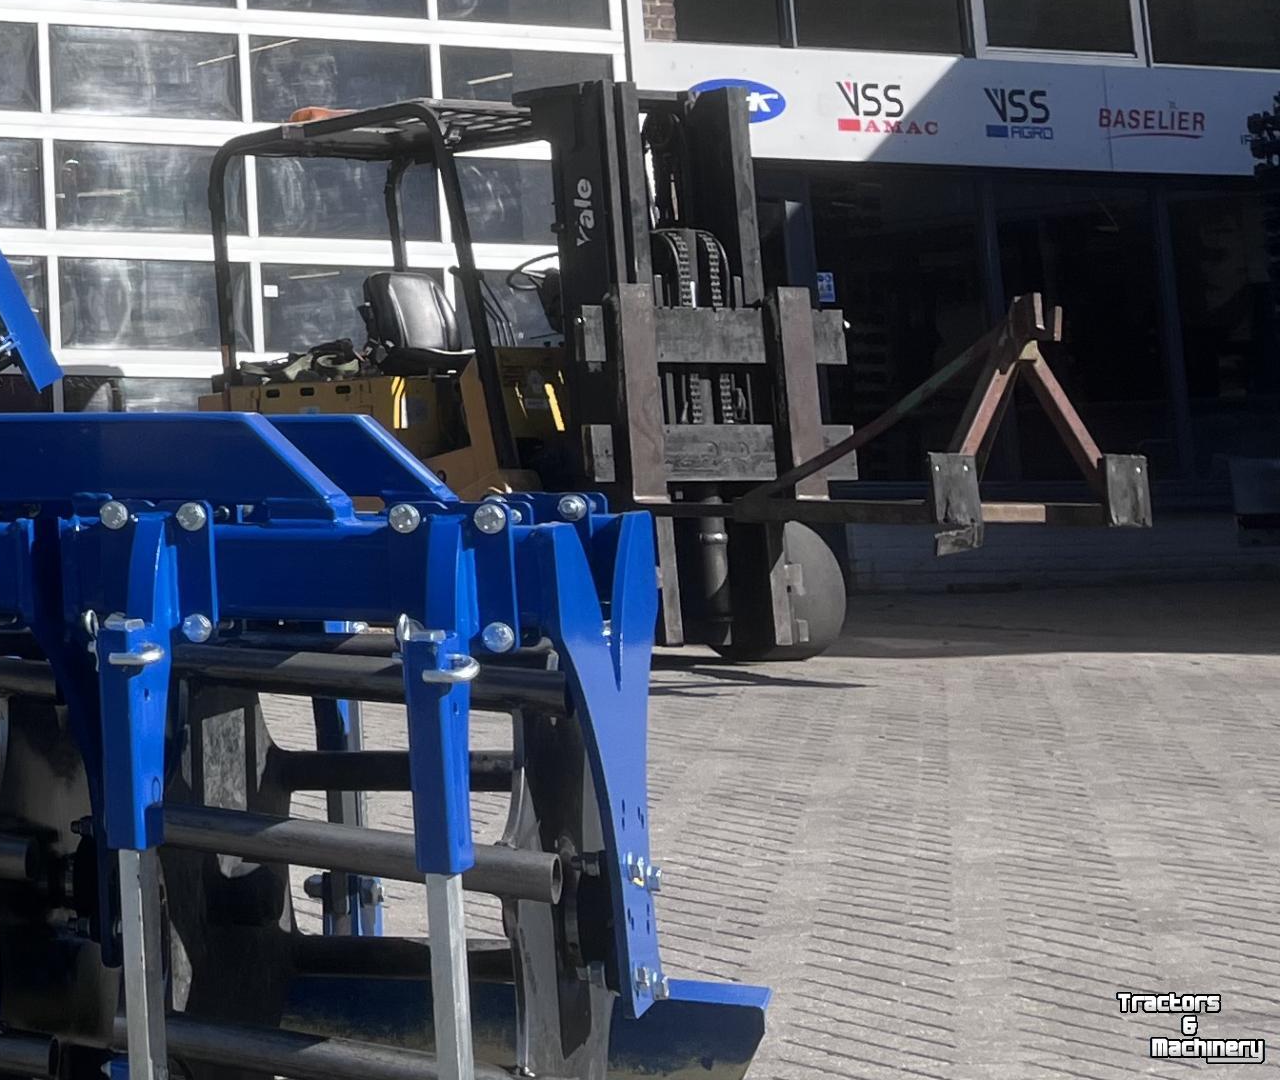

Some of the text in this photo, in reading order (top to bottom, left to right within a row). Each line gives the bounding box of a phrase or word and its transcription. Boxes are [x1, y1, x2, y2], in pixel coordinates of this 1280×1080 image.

[835, 81, 905, 118] VSS
[983, 88, 1051, 124] VSS
[864, 118, 939, 136] AMAC
[1098, 107, 1206, 132] BASELIER
[1011, 125, 1054, 140] AGRO
